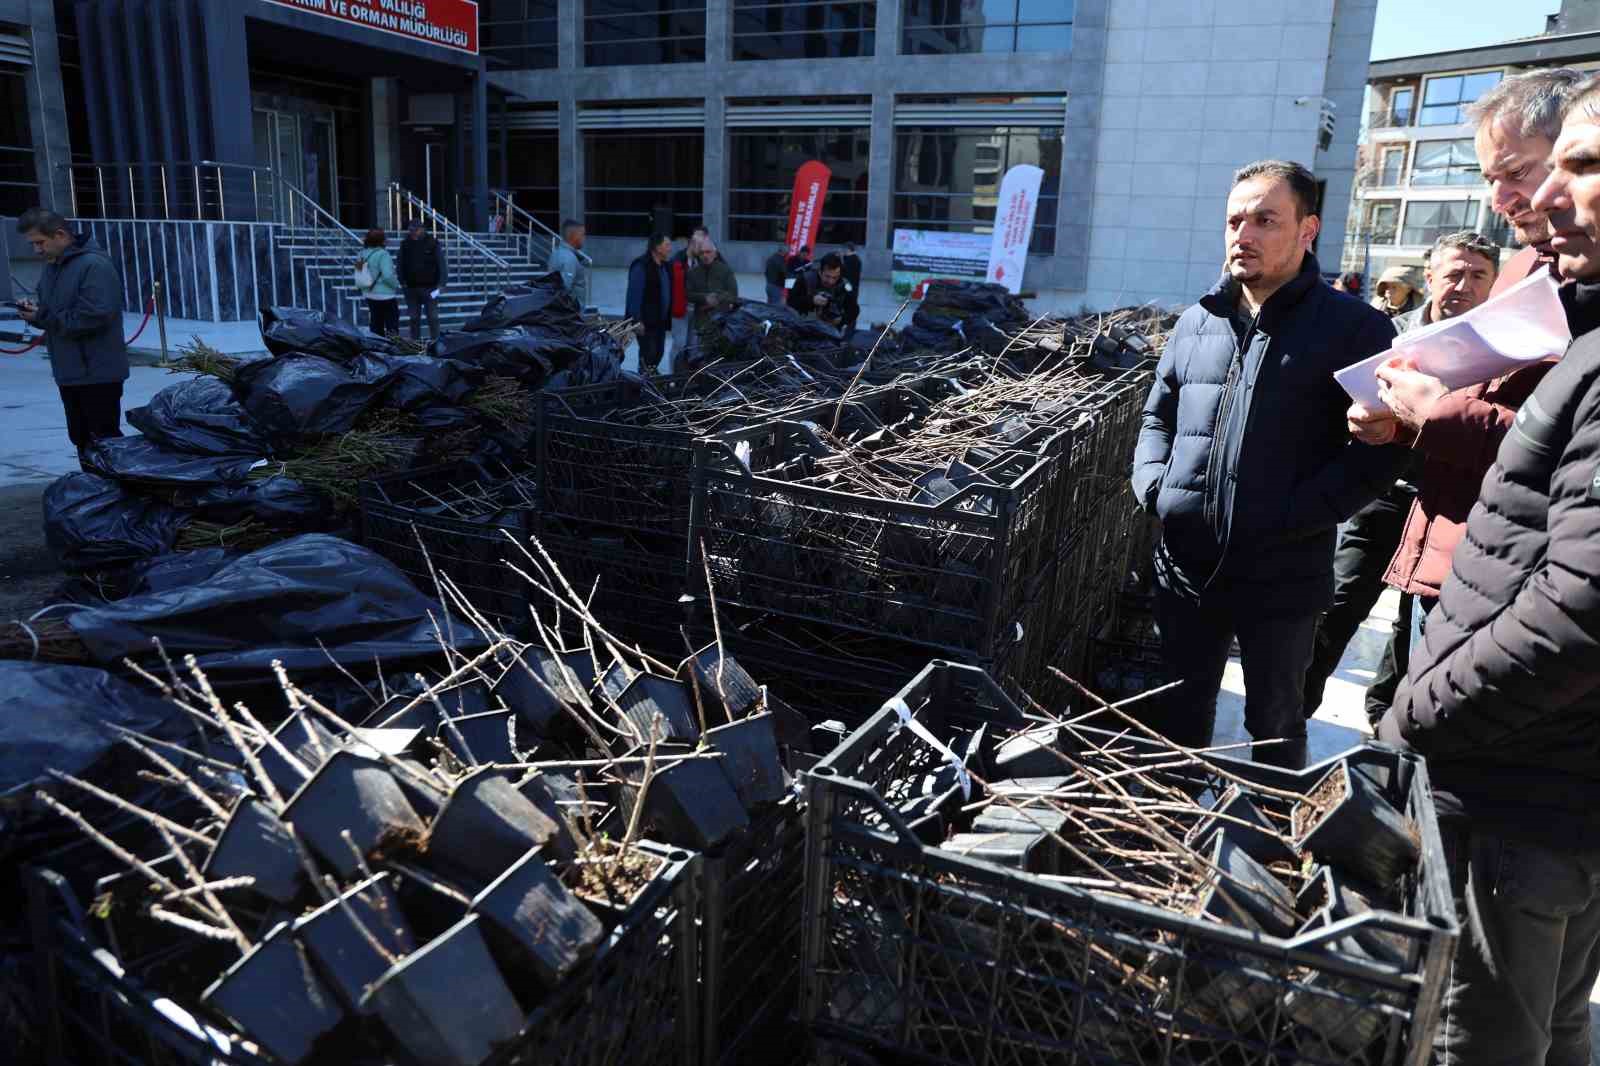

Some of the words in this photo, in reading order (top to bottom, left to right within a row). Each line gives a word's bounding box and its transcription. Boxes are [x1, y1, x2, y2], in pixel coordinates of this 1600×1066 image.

[331, 0, 347, 16] VE
[351, 4, 398, 28] ORMAN
[399, 16, 468, 47] MÜDÜRLÜĞÜ
